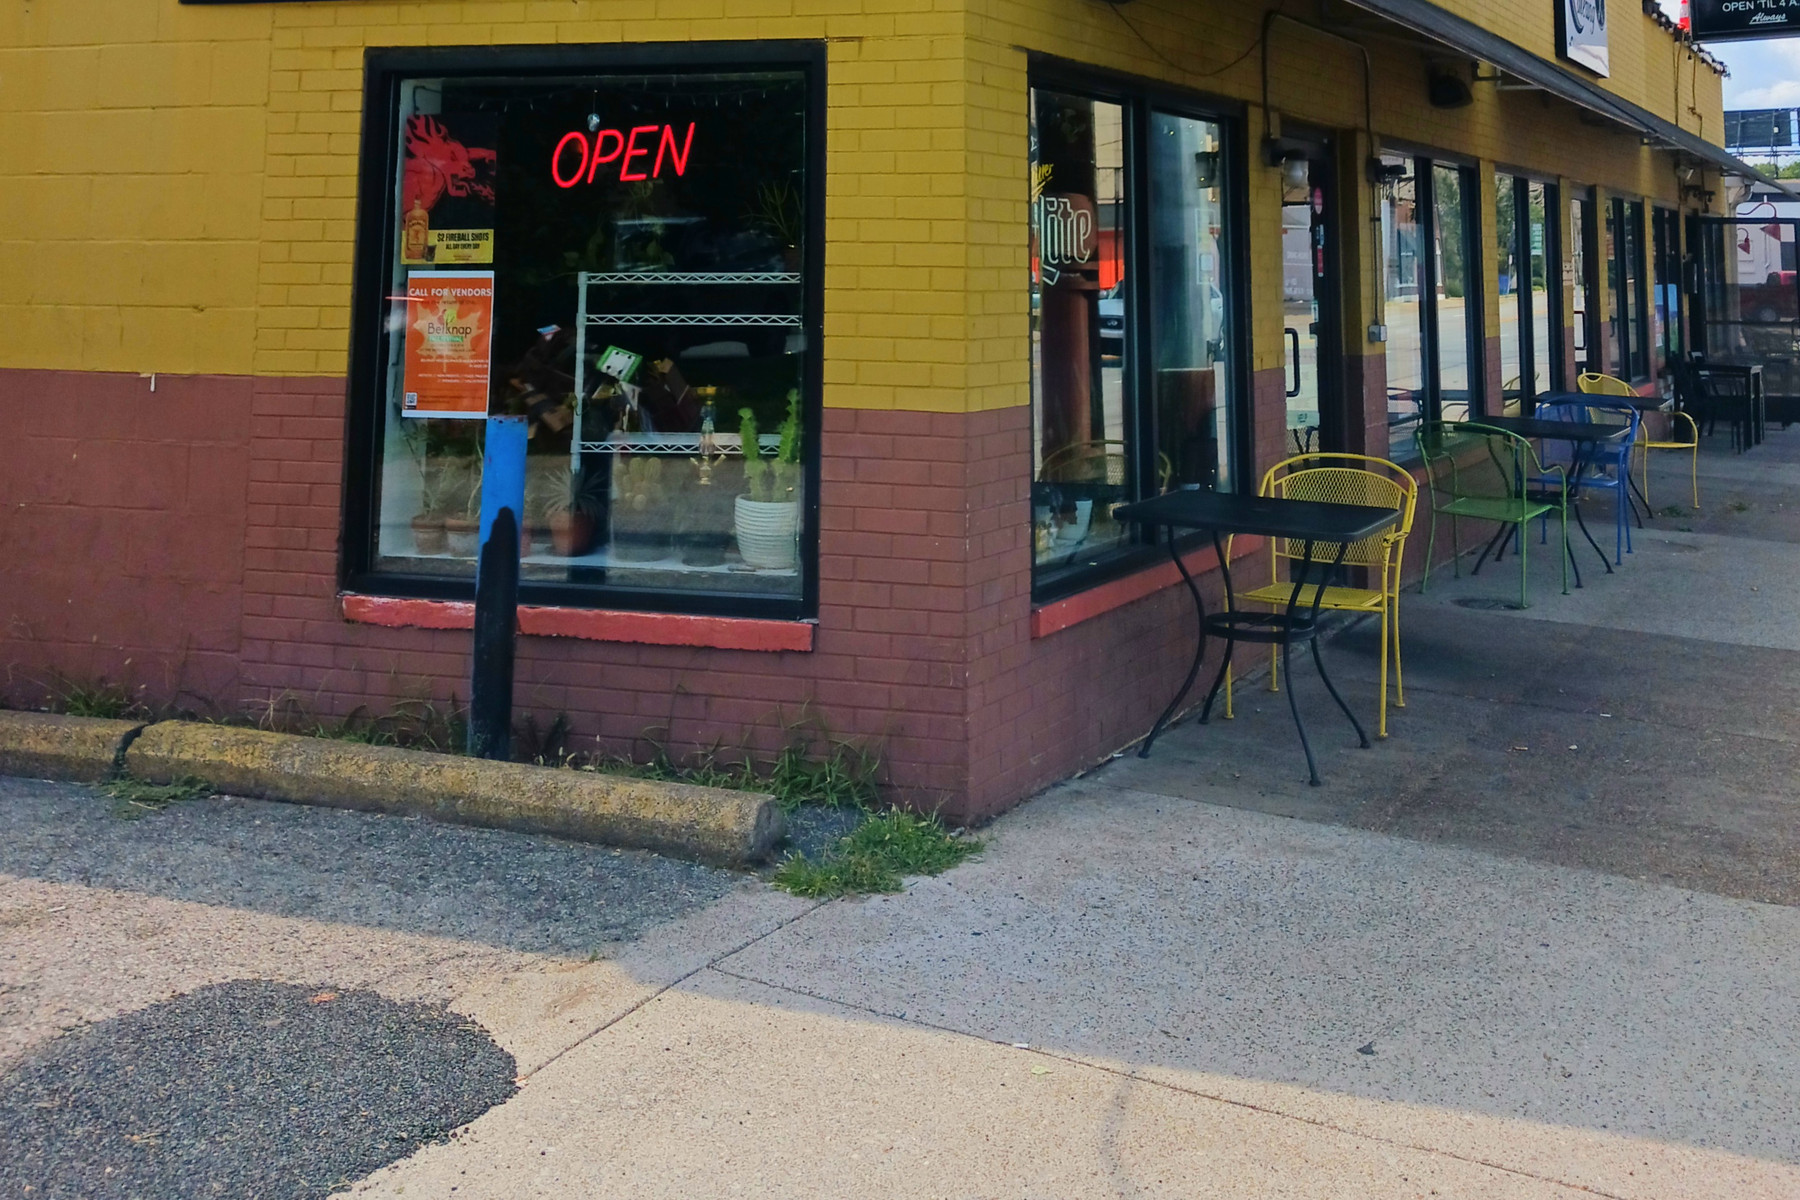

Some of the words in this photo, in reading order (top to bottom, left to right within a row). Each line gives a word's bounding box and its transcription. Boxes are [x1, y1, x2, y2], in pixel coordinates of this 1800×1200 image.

[1722, 0, 1755, 12] OPEN
[551, 121, 696, 189] OPEN
[437, 232, 445, 242] $2
[446, 232, 470, 242] FIREBALL
[471, 232, 490, 242] SHOTS
[409, 288, 428, 297] CALL
[431, 288, 448, 296] FOR
[451, 288, 492, 297] VENDORS
[428, 321, 472, 338] Belknap
